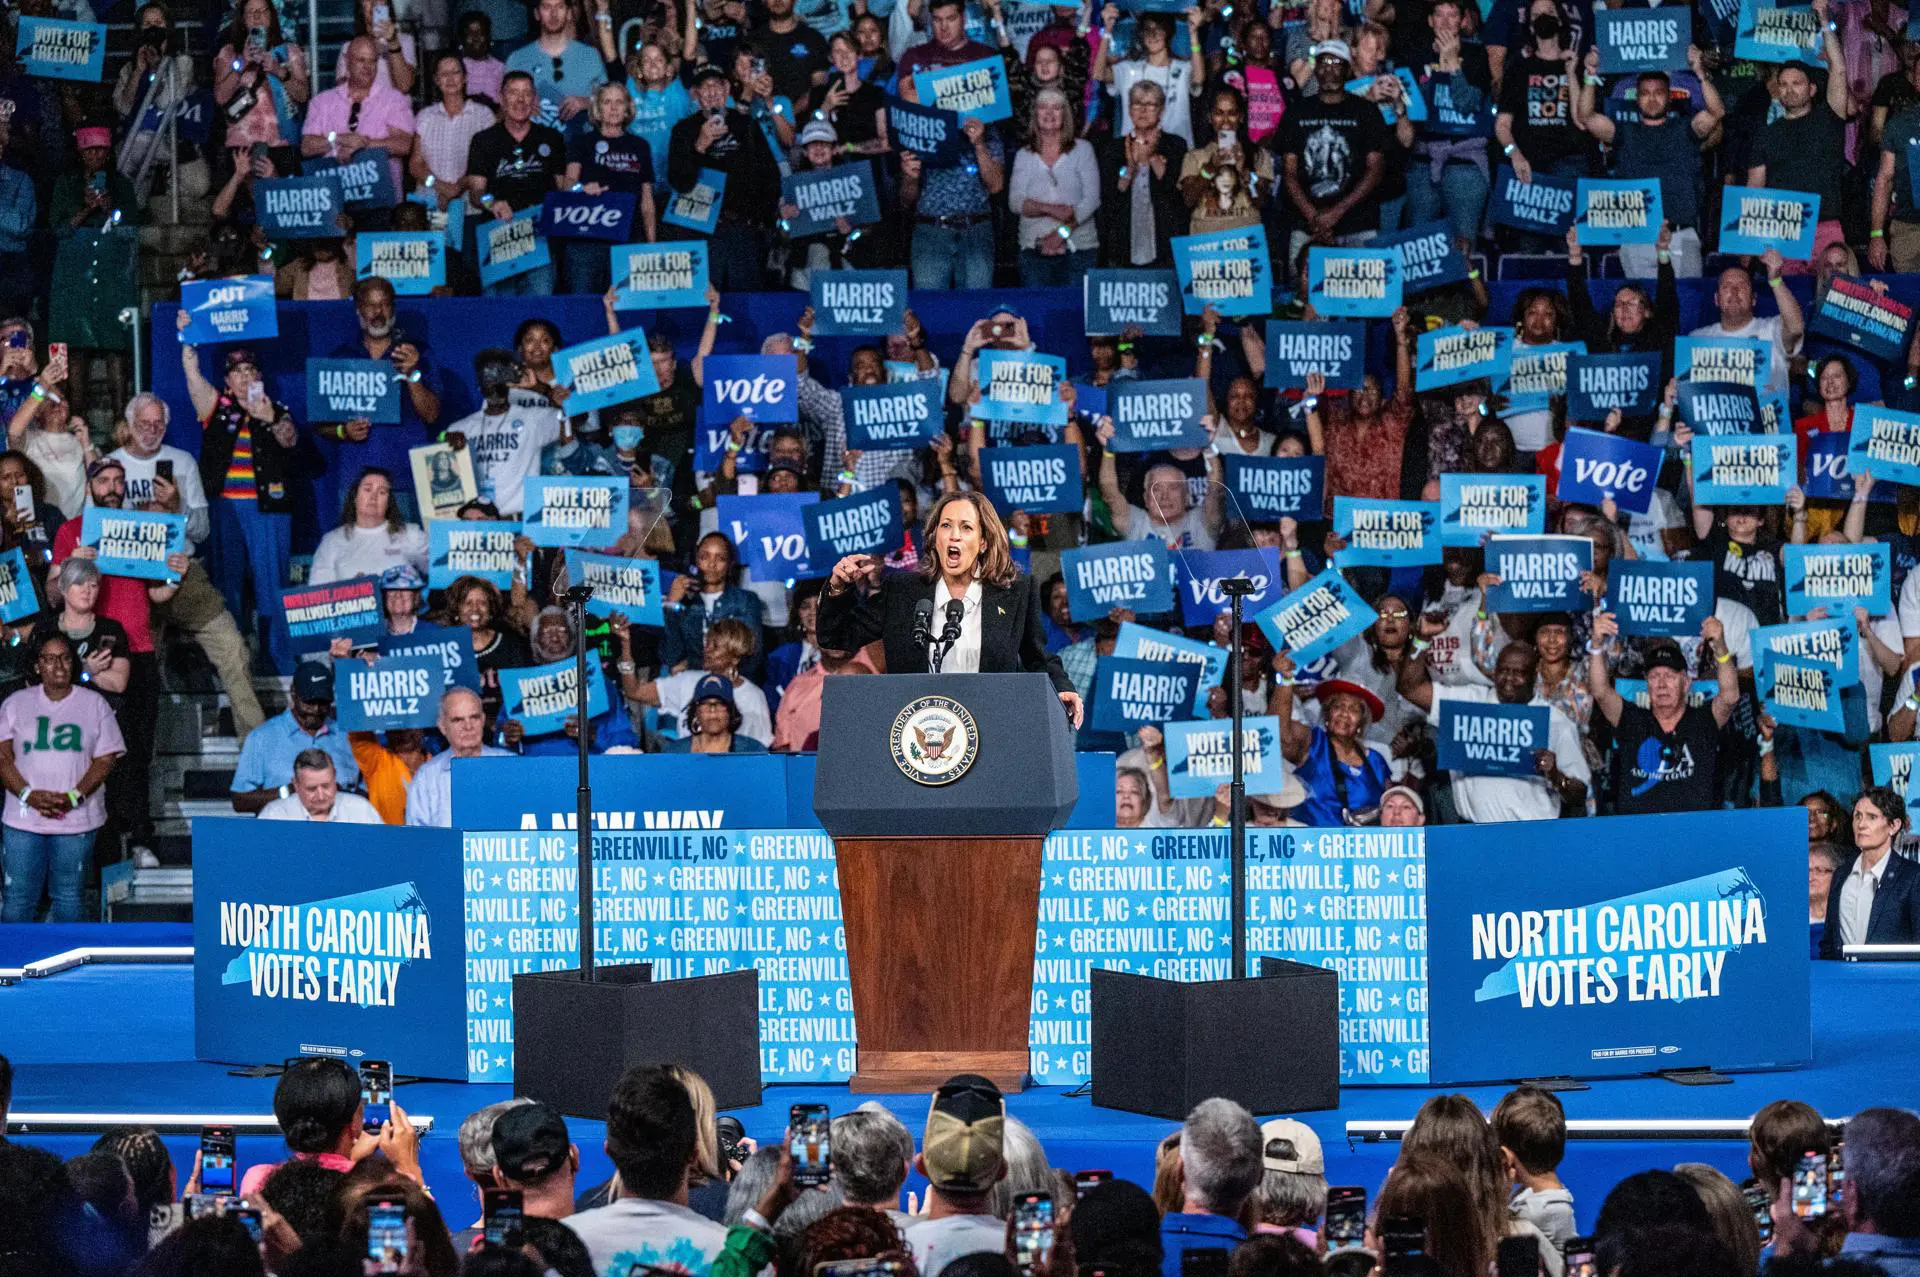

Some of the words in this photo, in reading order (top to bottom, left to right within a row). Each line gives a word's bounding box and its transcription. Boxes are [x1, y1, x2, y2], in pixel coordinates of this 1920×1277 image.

[1757, 8, 1789, 29] VOTE
[1791, 11, 1817, 31] FOR
[34, 26, 68, 47] VOTE
[69, 30, 92, 50] FOR
[1608, 20, 1678, 46] HARRIS
[32, 44, 90, 65] FREEDOM
[1620, 45, 1668, 60] WALZ
[933, 75, 964, 96] VOTE
[966, 69, 992, 88] FOR
[1527, 100, 1568, 117] ROE
[891, 106, 946, 142] HARRIS
[266, 187, 332, 213] HARRIS
[795, 176, 863, 210] HARRIS
[1505, 178, 1573, 212] HARRIS
[1588, 189, 1616, 209] VOTE
[1619, 190, 1645, 210] FOR
[277, 211, 324, 228] WALZ
[553, 204, 623, 229] vote
[808, 200, 857, 221] WALZ
[1512, 202, 1560, 224] WALZ
[1587, 208, 1647, 229] FREEDOM
[1740, 196, 1774, 217] VOTE
[1775, 199, 1801, 221] FOR
[1737, 216, 1801, 241] FREEDOM
[372, 240, 404, 260] VOTE
[405, 240, 429, 260] FOR
[629, 254, 663, 273] VOTE
[664, 252, 693, 272] FOR
[371, 258, 430, 280] FREEDOM
[1191, 260, 1223, 280] VOTE
[1225, 258, 1253, 279] FOR
[1324, 258, 1358, 279] VOTE
[1359, 258, 1386, 279] FOR
[629, 271, 694, 293] FREEDOM
[1192, 278, 1254, 299] FREEDOM
[1323, 278, 1386, 299] FREEDOM
[208, 286, 248, 304] OUT
[823, 282, 895, 308] HARRIS
[1099, 282, 1170, 308] HARRIS
[833, 307, 884, 324] WALZ
[1109, 307, 1159, 324] WALZ
[1280, 335, 1353, 361] HARRIS
[1434, 333, 1467, 357] VOTE
[1468, 329, 1496, 351] FOR
[570, 351, 606, 378] VOTE
[605, 345, 635, 369] FOR
[1289, 359, 1341, 379] WALZ
[1433, 346, 1495, 373] FREEDOM
[1691, 347, 1725, 367] VOTE
[1726, 347, 1755, 367] FOR
[319, 370, 387, 398] HARRIS
[574, 362, 640, 397] FREEDOM
[992, 361, 1026, 382] VOTE
[1027, 363, 1053, 383] FOR
[1579, 365, 1649, 392] HARRIS
[1690, 366, 1755, 386] FREEDOM
[713, 373, 787, 404] vote
[989, 381, 1052, 405] FREEDOM
[1590, 391, 1639, 409] WALZ
[329, 396, 377, 412] WALZ
[854, 394, 929, 426] HARRIS
[1117, 392, 1193, 422] HARRIS
[1691, 394, 1755, 422] HARRIS
[867, 421, 921, 444] WALZ
[1130, 420, 1184, 439] WALZ
[1871, 418, 1907, 443] VOTE
[1711, 444, 1746, 466] VOTE
[1749, 444, 1779, 466] FOR
[992, 459, 1067, 488] HARRIS
[1239, 467, 1313, 497] HARRIS
[1574, 458, 1649, 493] vote
[1711, 464, 1779, 487] FREEDOM
[542, 486, 577, 508] VOTE
[580, 486, 611, 508] FOR
[1004, 485, 1058, 506] WALZ
[1249, 494, 1302, 512] WALZ
[1460, 485, 1496, 507] VOTE
[1499, 485, 1529, 507] FOR
[541, 506, 611, 529] FREEDOM
[818, 500, 892, 543] HARRIS
[1353, 508, 1390, 531] VOTE
[1392, 510, 1423, 532] FOR
[1460, 505, 1529, 529] FREEDOM
[101, 517, 137, 542] VOTE
[139, 521, 169, 544] FOR
[448, 530, 483, 552] VOTE
[484, 530, 515, 552] FOR
[1351, 530, 1424, 552] FREEDOM
[99, 537, 166, 563] FREEDOM
[832, 531, 886, 558] WALZ
[447, 550, 516, 573] FREEDOM
[1077, 553, 1157, 594] HARRIS
[1499, 553, 1579, 581] HARRIS
[1804, 554, 1840, 577] VOTE
[1841, 555, 1873, 577] FOR
[582, 562, 617, 584] VOTE
[617, 565, 643, 588] FOR
[1803, 575, 1874, 599] FREEDOM
[1091, 583, 1146, 608] WALZ
[1510, 580, 1567, 600] WALZ
[1618, 575, 1699, 606] HARRIS
[1272, 600, 1305, 635] VOTE
[1304, 586, 1339, 615] FOR
[1628, 603, 1686, 624] WALZ
[1284, 605, 1353, 653] FREEDOM
[1810, 628, 1842, 653] FOR
[350, 670, 430, 700] HARRIS
[519, 674, 555, 703] VOTE
[1109, 671, 1189, 704] HARRIS
[1774, 662, 1802, 688] VOTE
[1801, 664, 1824, 690] FOR
[362, 698, 419, 718] WALZ
[919, 700, 931, 708] OF
[933, 699, 950, 708] THE
[1121, 700, 1174, 721] WALZ
[1774, 683, 1828, 713] FREEDOM
[23, 716, 84, 754] ,la
[892, 704, 916, 758] PRESIDENT
[952, 704, 976, 741] UNITED
[1453, 715, 1534, 747] HARRIS
[1186, 731, 1220, 755] VOTE
[1465, 743, 1521, 763] WALZ
[899, 759, 920, 780] VICE
[948, 745, 976, 779] STATES
[543, 838, 566, 860] NC
[703, 837, 728, 860] NC
[1105, 837, 1130, 859] NC
[1268, 834, 1296, 859] NC
[622, 866, 647, 891] NC
[668, 865, 783, 896] GREENVILLE,
[785, 866, 811, 891] NC
[1069, 865, 1183, 895] GREENVILLE,
[1185, 865, 1212, 890] NC
[1354, 864, 1381, 890] NC
[220, 901, 298, 949] NORTH
[305, 905, 432, 959] CAROLINA
[1471, 908, 1588, 960] NORTH
[1595, 897, 1767, 953] CAROLINA
[248, 950, 321, 1002] VOTES
[326, 955, 400, 1006] EARLY
[1515, 957, 1619, 1009] VOTES
[1626, 949, 1728, 1004] EARLY
